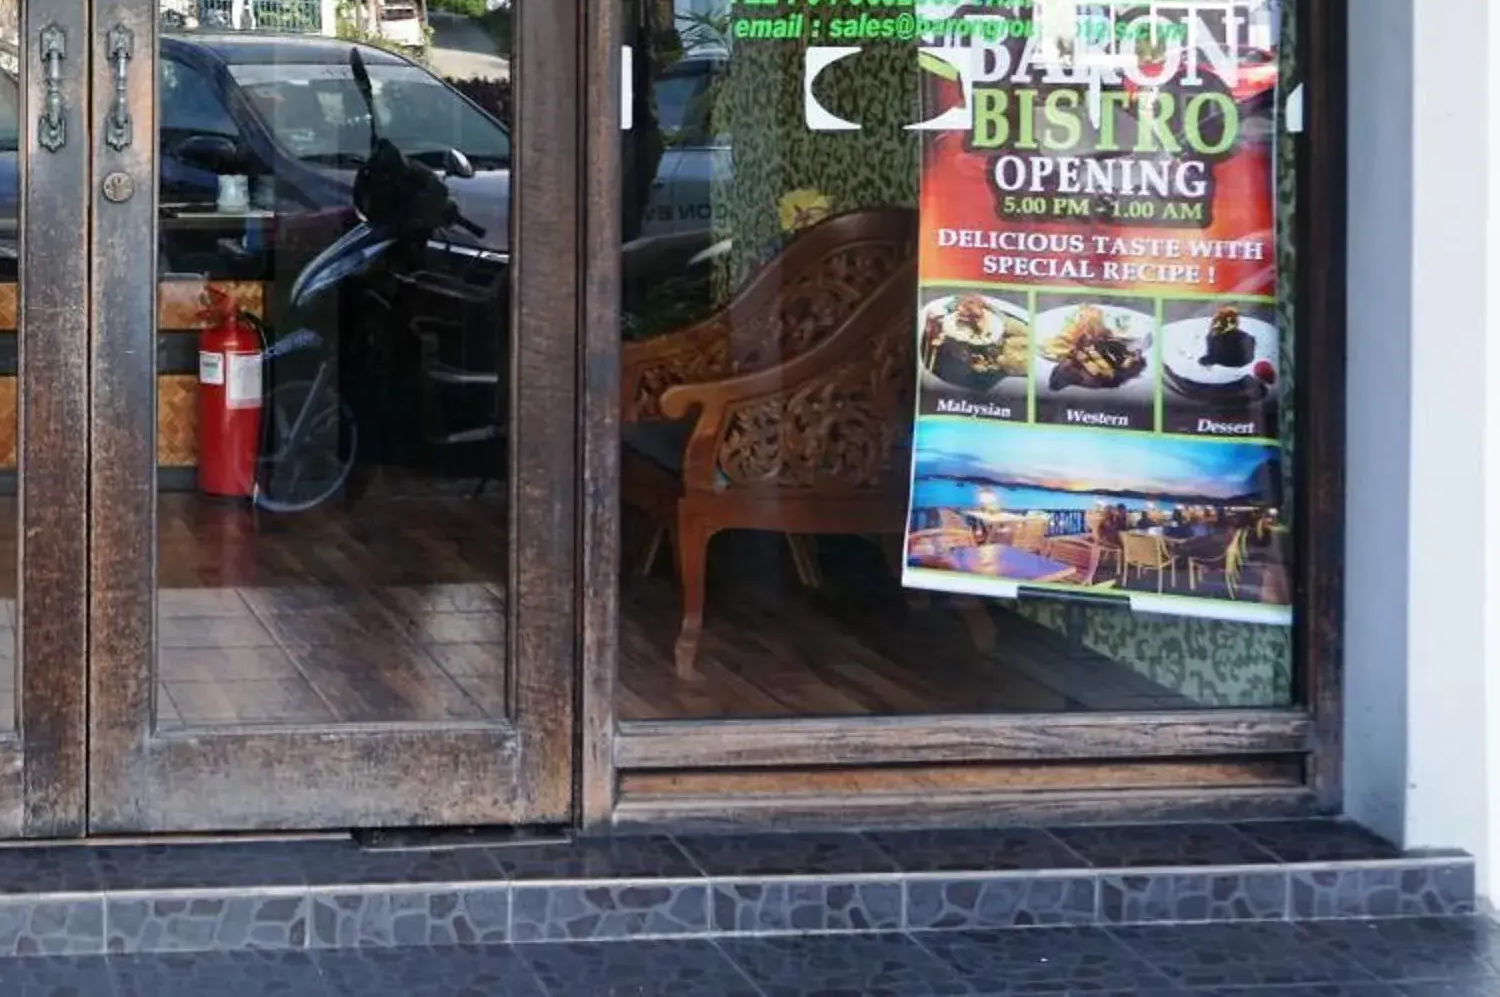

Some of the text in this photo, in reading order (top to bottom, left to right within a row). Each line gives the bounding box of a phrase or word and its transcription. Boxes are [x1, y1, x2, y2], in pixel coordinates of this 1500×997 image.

[733, 13, 805, 39] email
[971, 88, 1240, 154] BISTRO
[994, 155, 1208, 198] OPENING
[1003, 196, 1047, 215] 5.00
[1053, 197, 1090, 217] PM
[1112, 201, 1155, 219] 1.00
[1162, 202, 1204, 220] AM
[938, 228, 1265, 261] DELICIOUS TASTE WITH
[982, 254, 1096, 280] SPECIAL
[1102, 263, 1201, 284] RECIPE
[936, 399, 1013, 421] Malaysian
[1065, 409, 1130, 426] Western
[1197, 418, 1256, 434] Dessert
